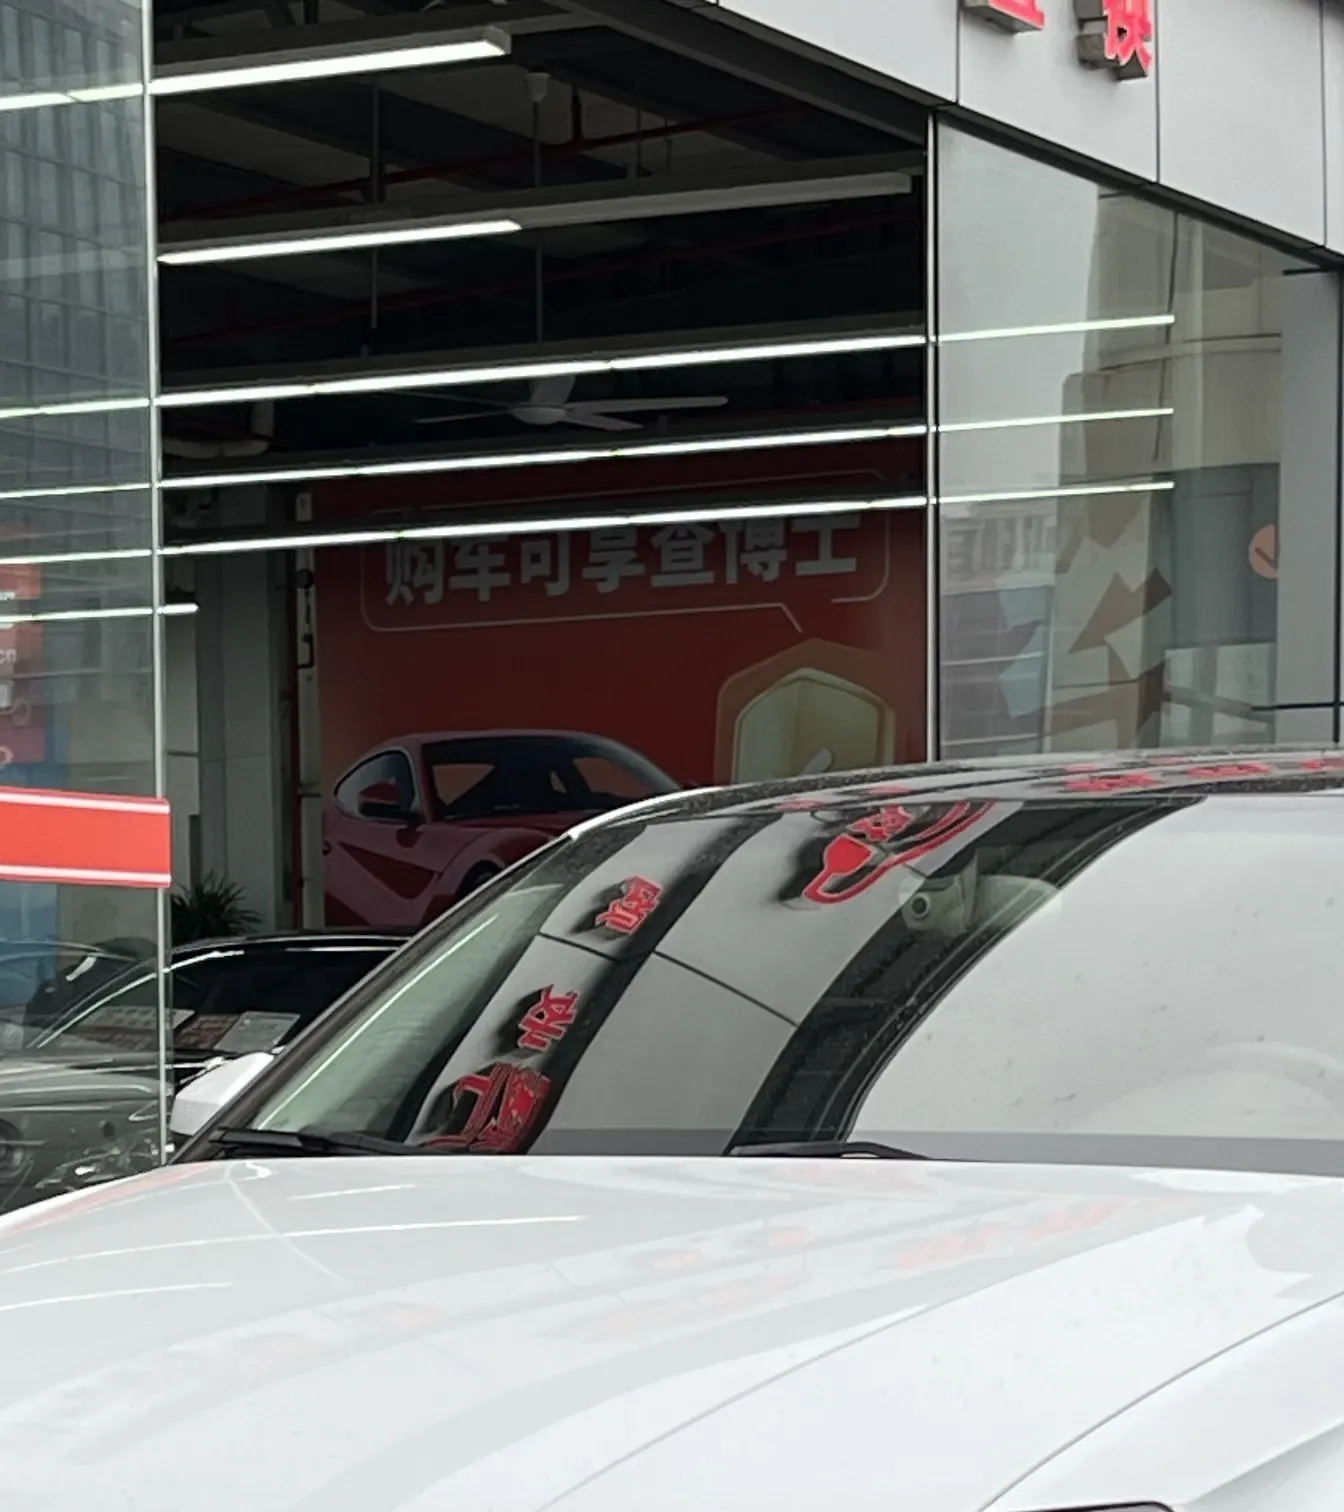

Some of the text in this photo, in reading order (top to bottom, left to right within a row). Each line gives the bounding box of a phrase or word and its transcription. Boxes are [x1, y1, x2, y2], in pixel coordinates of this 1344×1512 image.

[384, 515, 863, 607] 购车可享查博士
